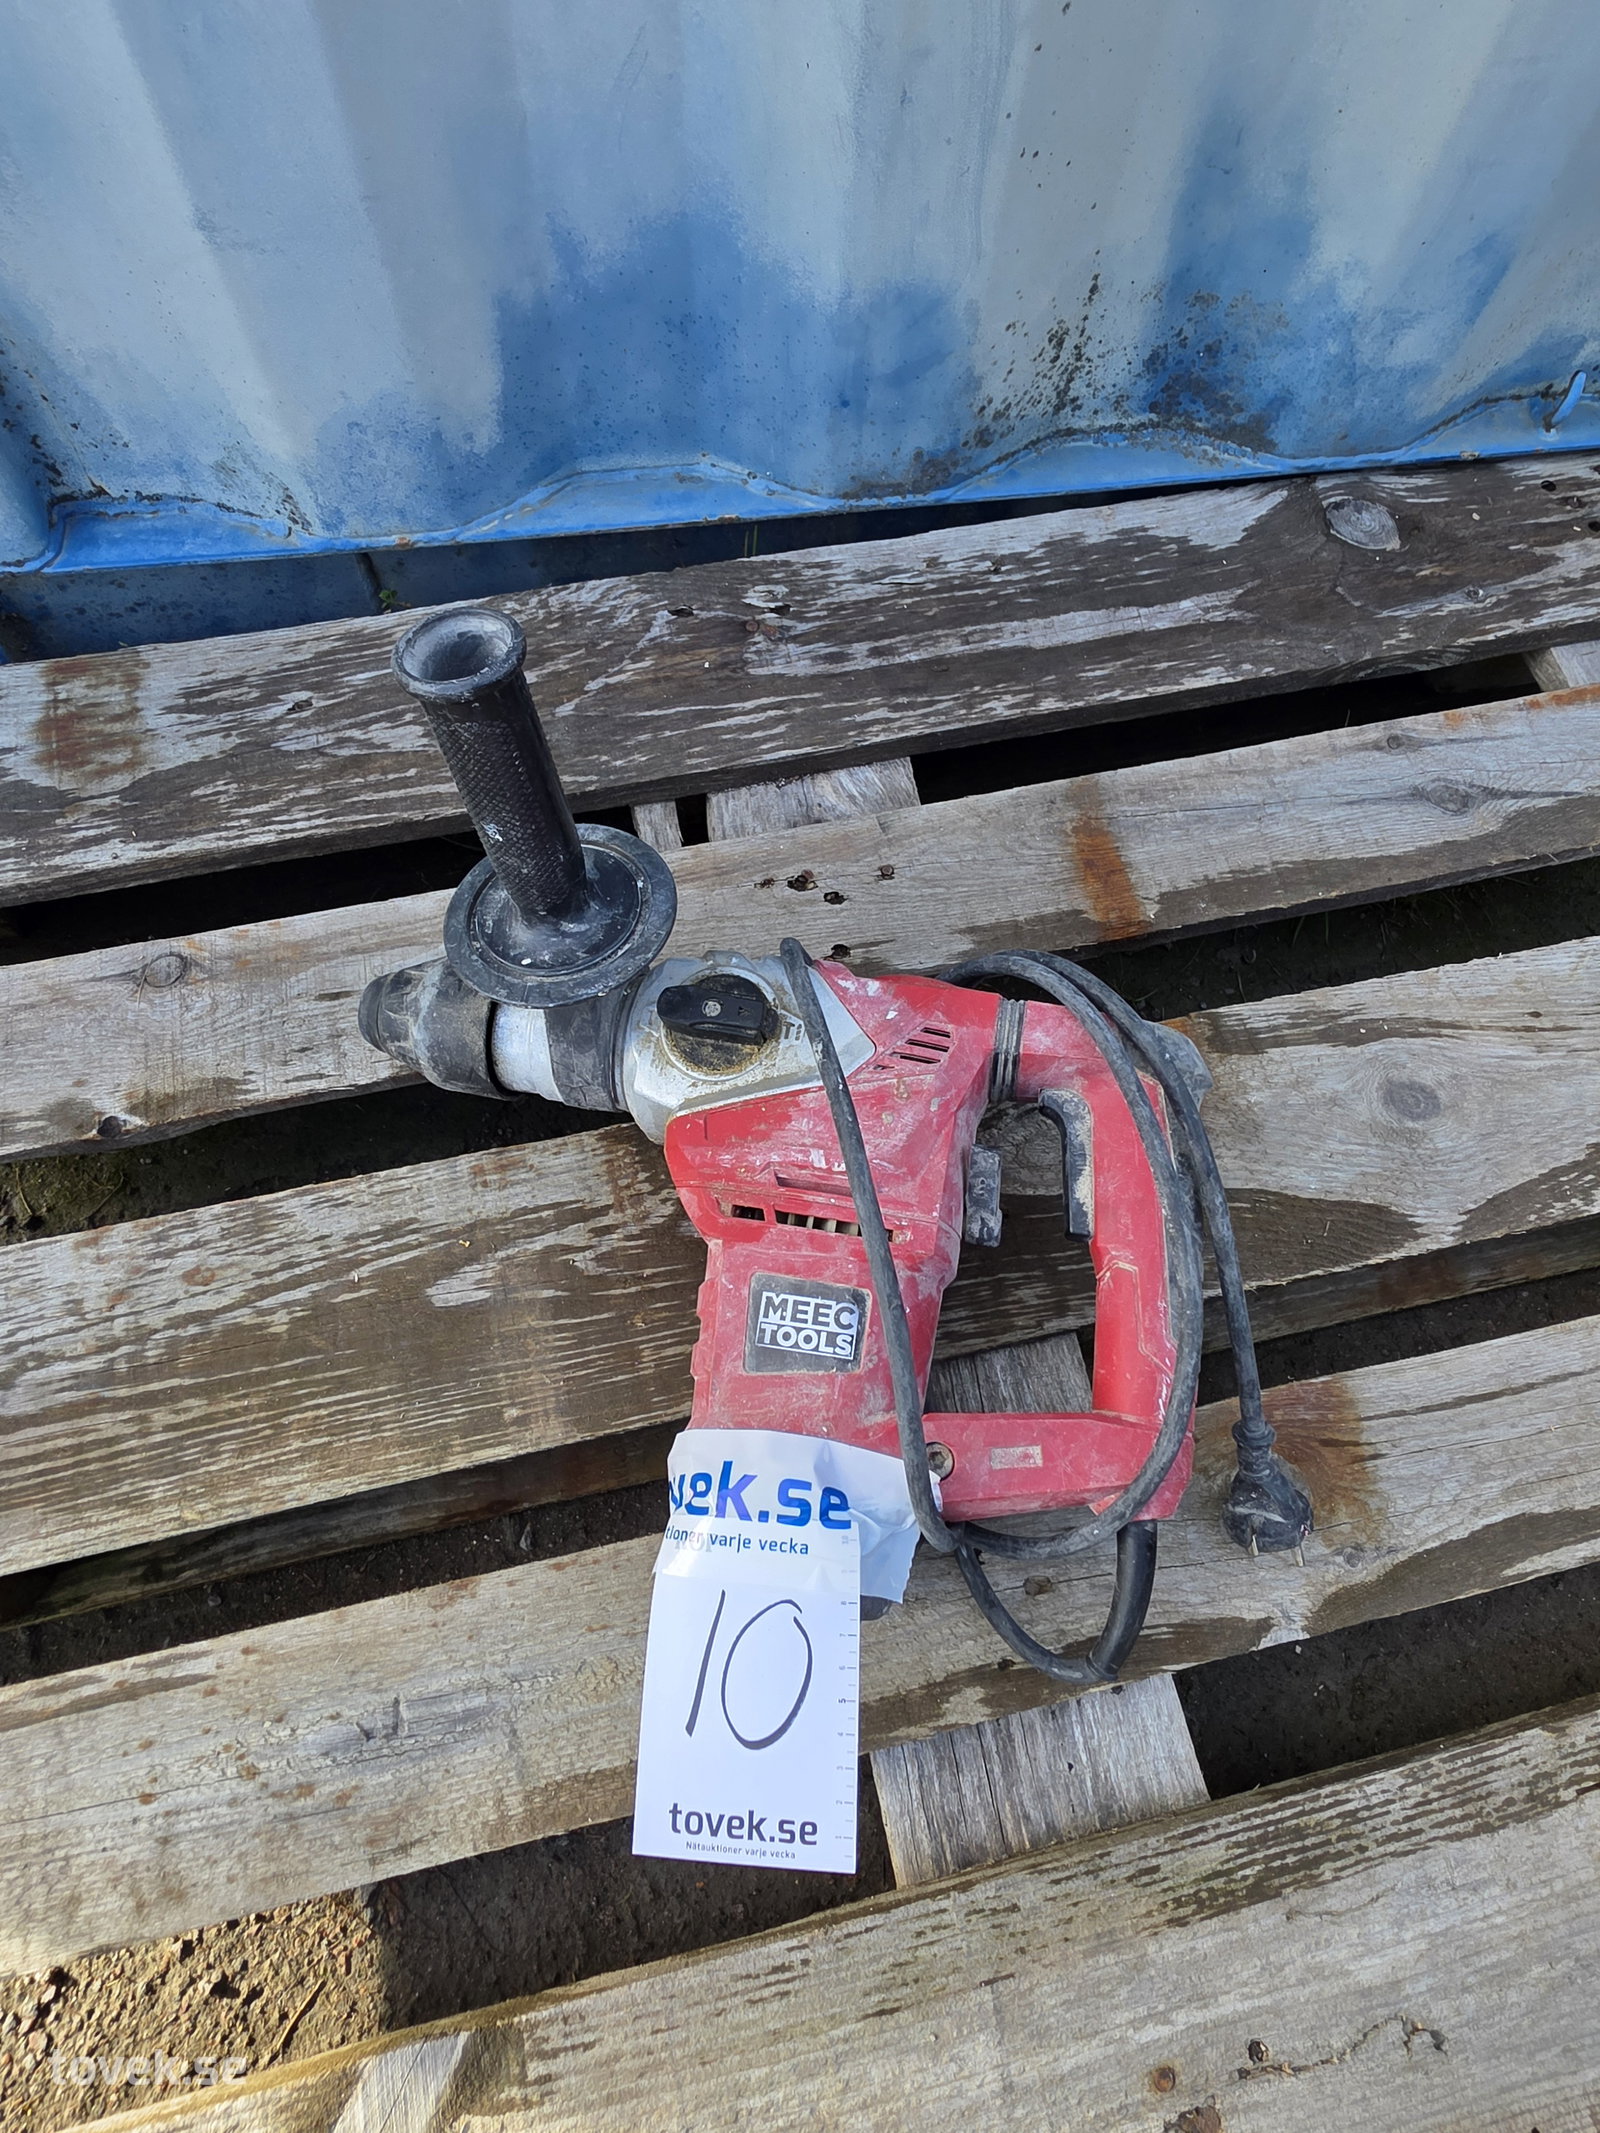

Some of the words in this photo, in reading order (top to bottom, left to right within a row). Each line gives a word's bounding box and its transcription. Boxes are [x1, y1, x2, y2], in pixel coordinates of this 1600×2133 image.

[762, 1294, 857, 1331] MEEC
[760, 1323, 853, 1355] TOOLS
[709, 1532, 751, 1554] varje
[758, 1538, 809, 1555] vecka
[685, 1589, 813, 1751] 10
[669, 1802, 818, 1846] tovek.se
[685, 1841, 743, 1856] Nätauktioner
[745, 1846, 767, 1860] varje
[770, 1847, 796, 1860] vecka
